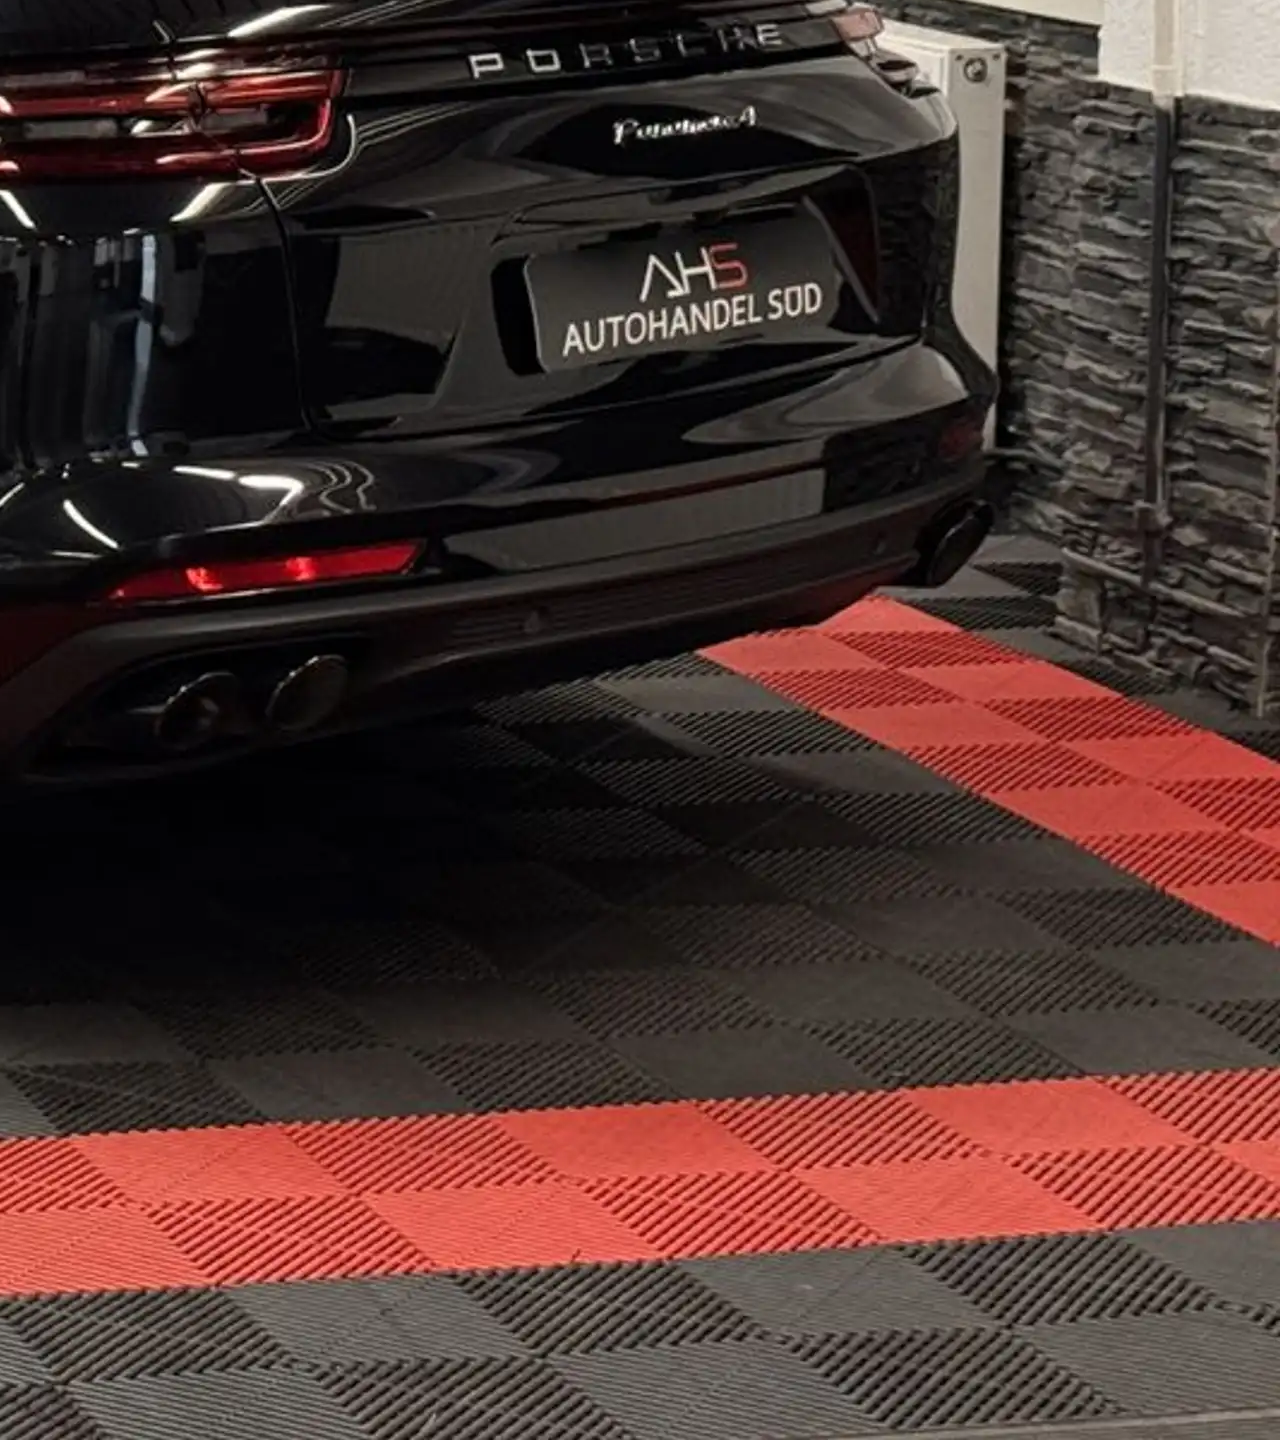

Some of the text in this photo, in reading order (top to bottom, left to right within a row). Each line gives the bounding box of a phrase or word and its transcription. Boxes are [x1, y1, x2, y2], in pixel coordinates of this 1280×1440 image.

[639, 242, 749, 303] AHS
[561, 282, 823, 357] AUTOHANDEL SÜD
